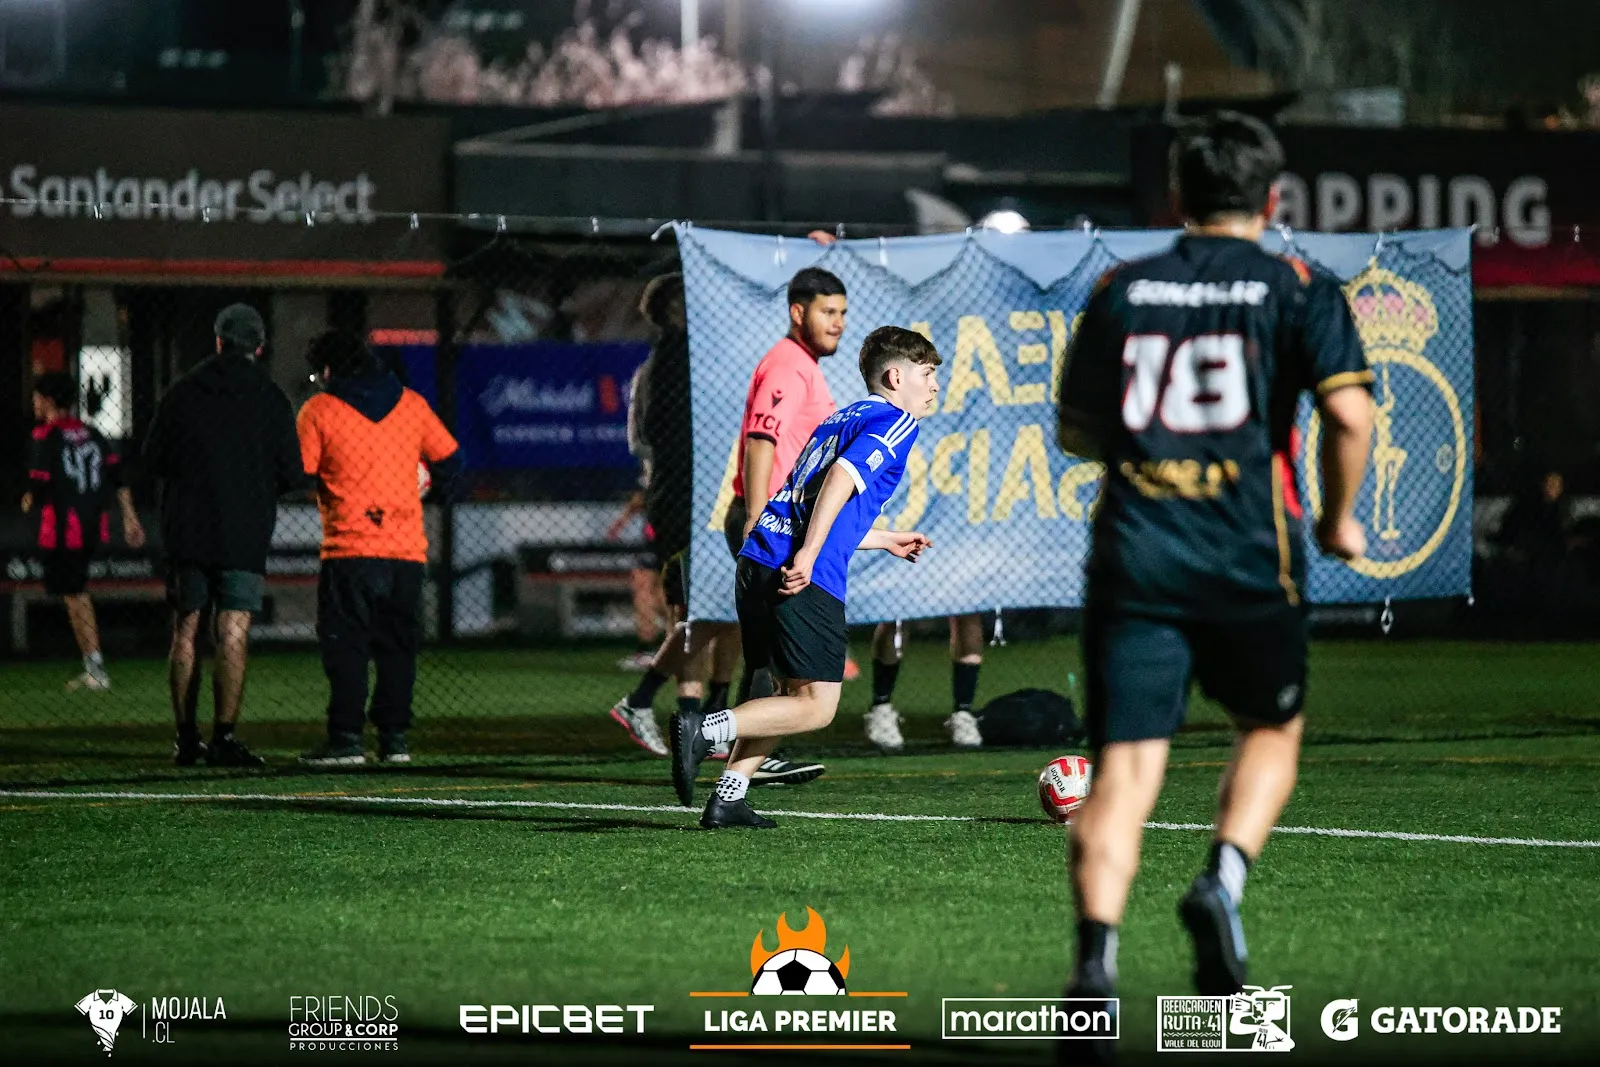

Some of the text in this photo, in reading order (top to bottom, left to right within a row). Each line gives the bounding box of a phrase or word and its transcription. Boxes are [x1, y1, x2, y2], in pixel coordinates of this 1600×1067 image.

[10, 164, 375, 225] Santander Select
[1273, 171, 1552, 247] APPING
[1121, 332, 1251, 433] 18
[754, 413, 782, 437] TCL
